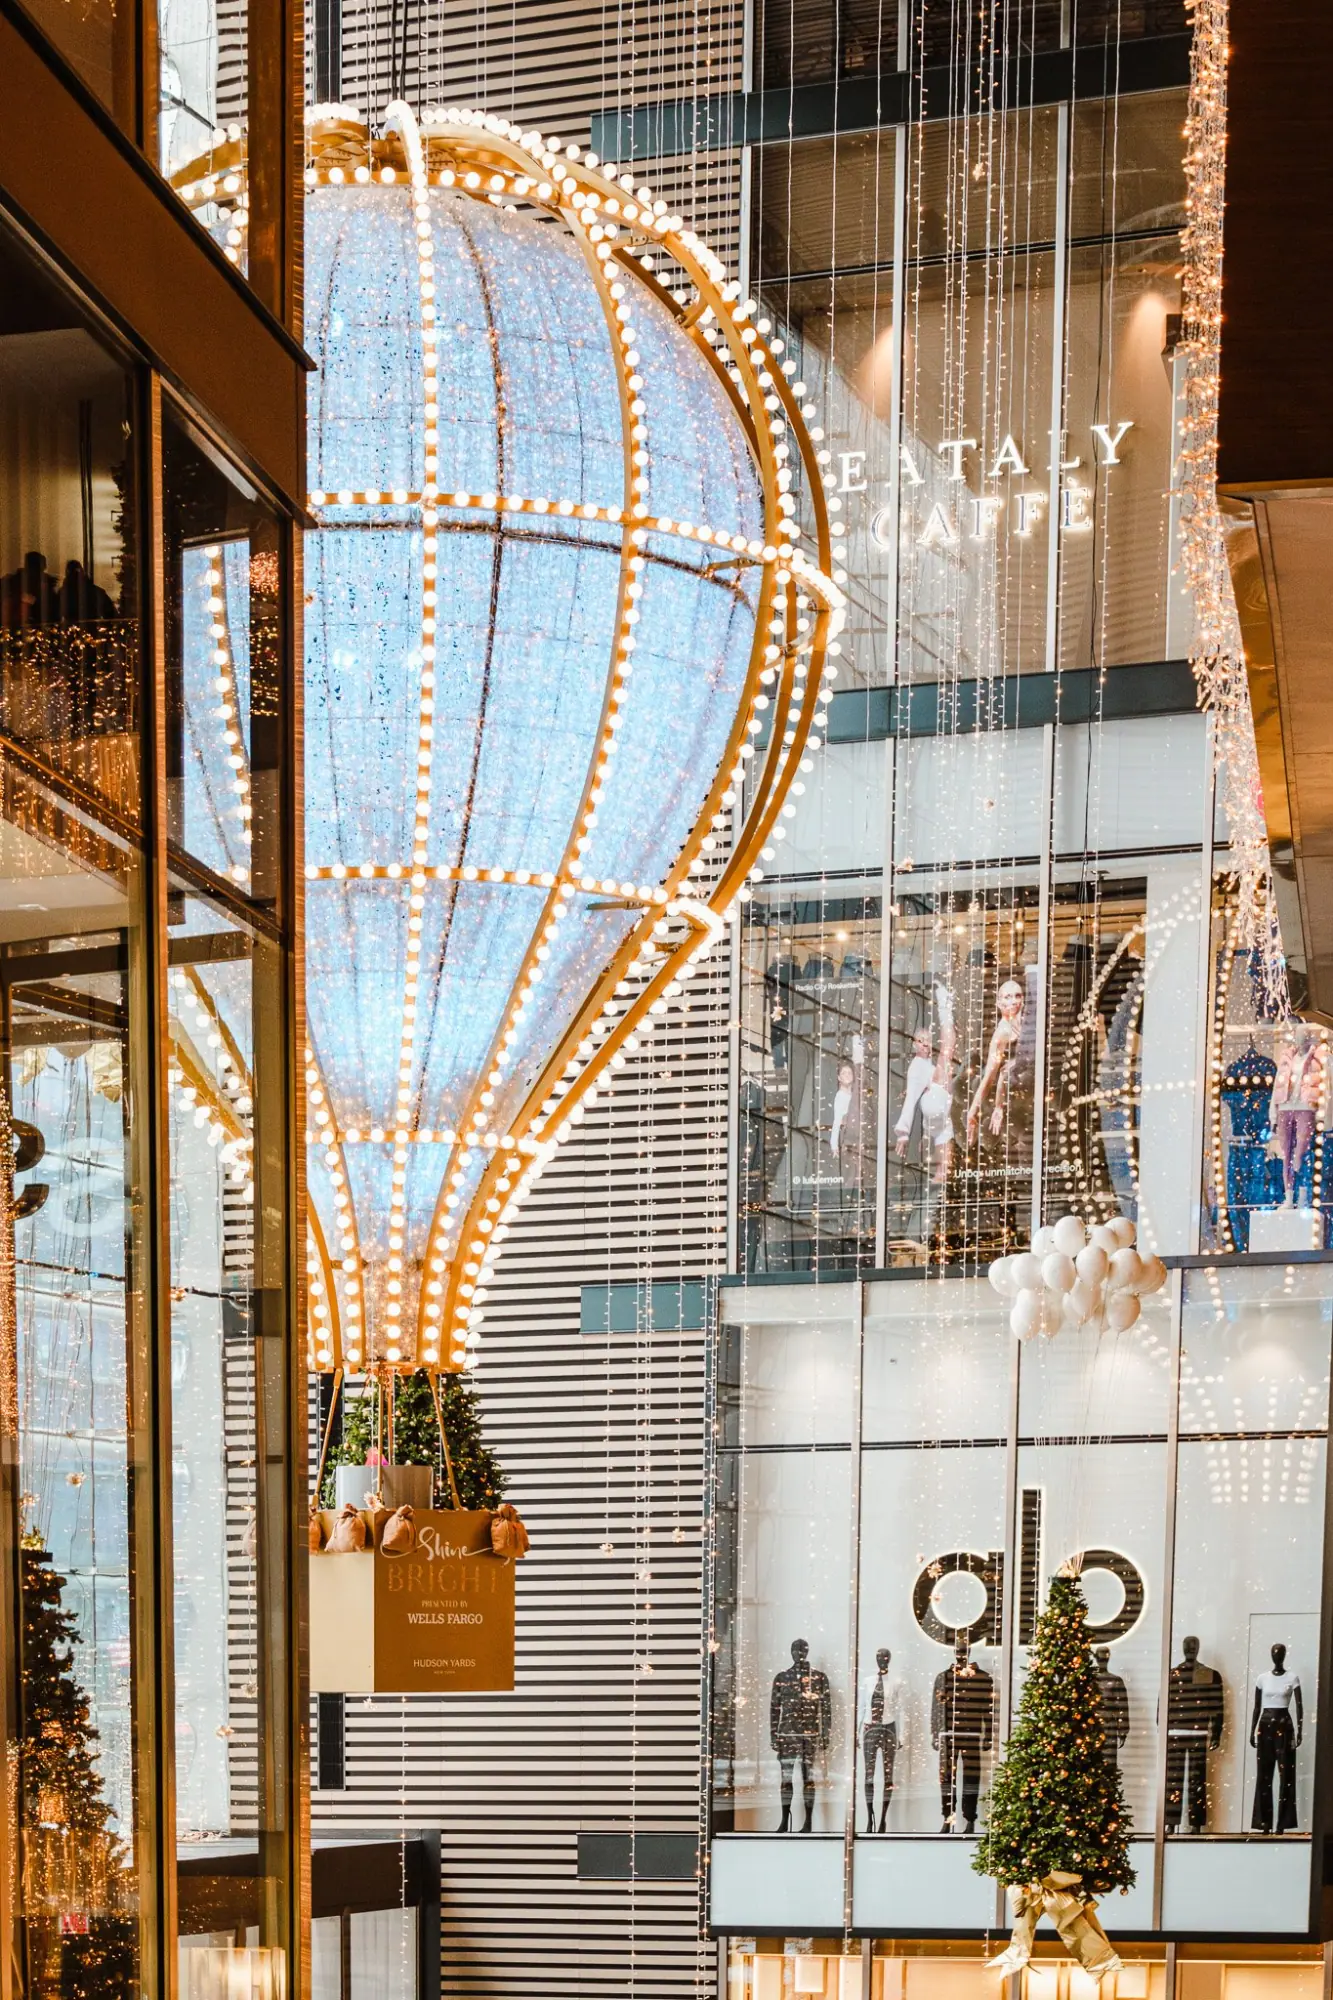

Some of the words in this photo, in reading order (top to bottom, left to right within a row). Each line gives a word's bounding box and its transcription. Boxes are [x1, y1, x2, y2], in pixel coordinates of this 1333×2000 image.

[837, 421, 1135, 493] EATALY
[985, 1165, 1035, 1178] unmatche
[912, 1488, 1146, 1648] alo
[388, 1563, 502, 1594] BRIGHT
[421, 1600, 459, 1609] PRESENTED
[460, 1600, 469, 1609] BY
[407, 1613, 445, 1625] WELLS
[447, 1613, 484, 1625] FARGO
[413, 1659, 449, 1668] HUDSON
[450, 1659, 477, 1668] YARDS
